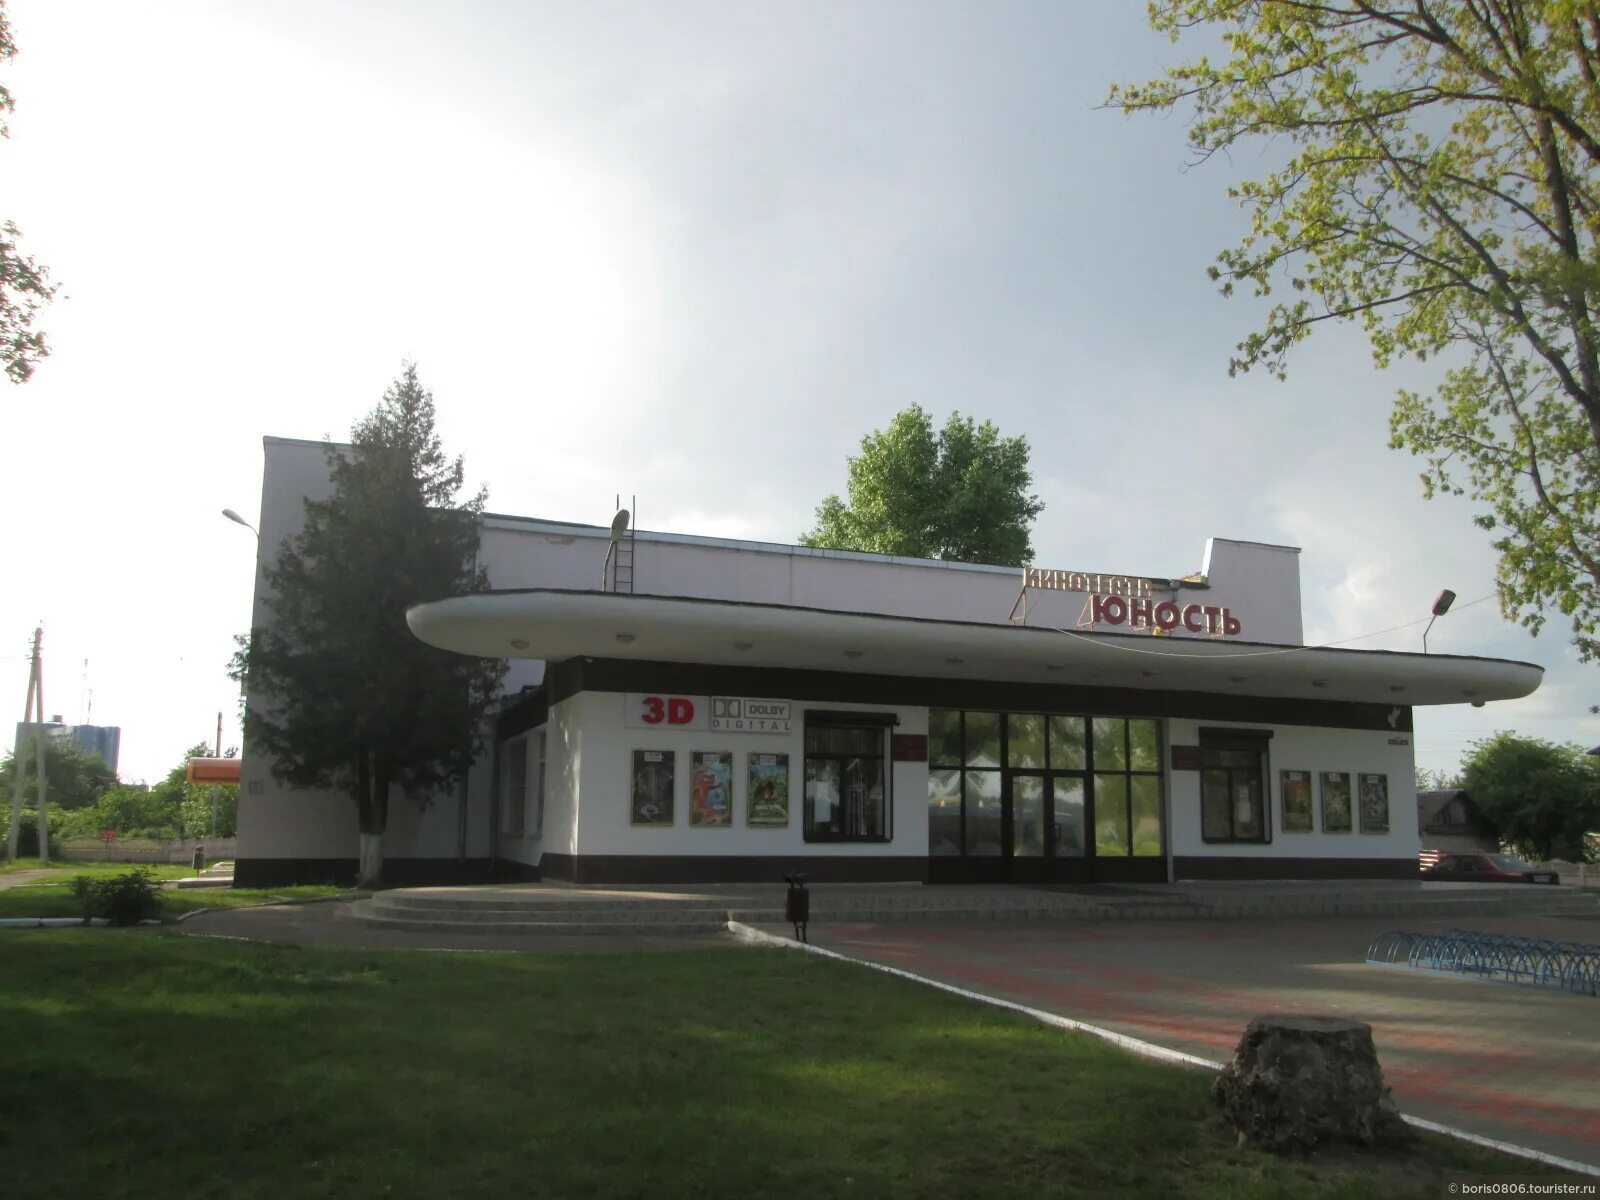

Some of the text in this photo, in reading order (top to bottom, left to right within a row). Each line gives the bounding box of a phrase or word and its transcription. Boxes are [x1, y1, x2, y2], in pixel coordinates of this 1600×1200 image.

[1091, 594, 1241, 635] ЮНОСТЬ
[641, 696, 694, 725] 3D
[749, 704, 785, 716] DOLBY
[712, 719, 791, 731] DIGITAL
